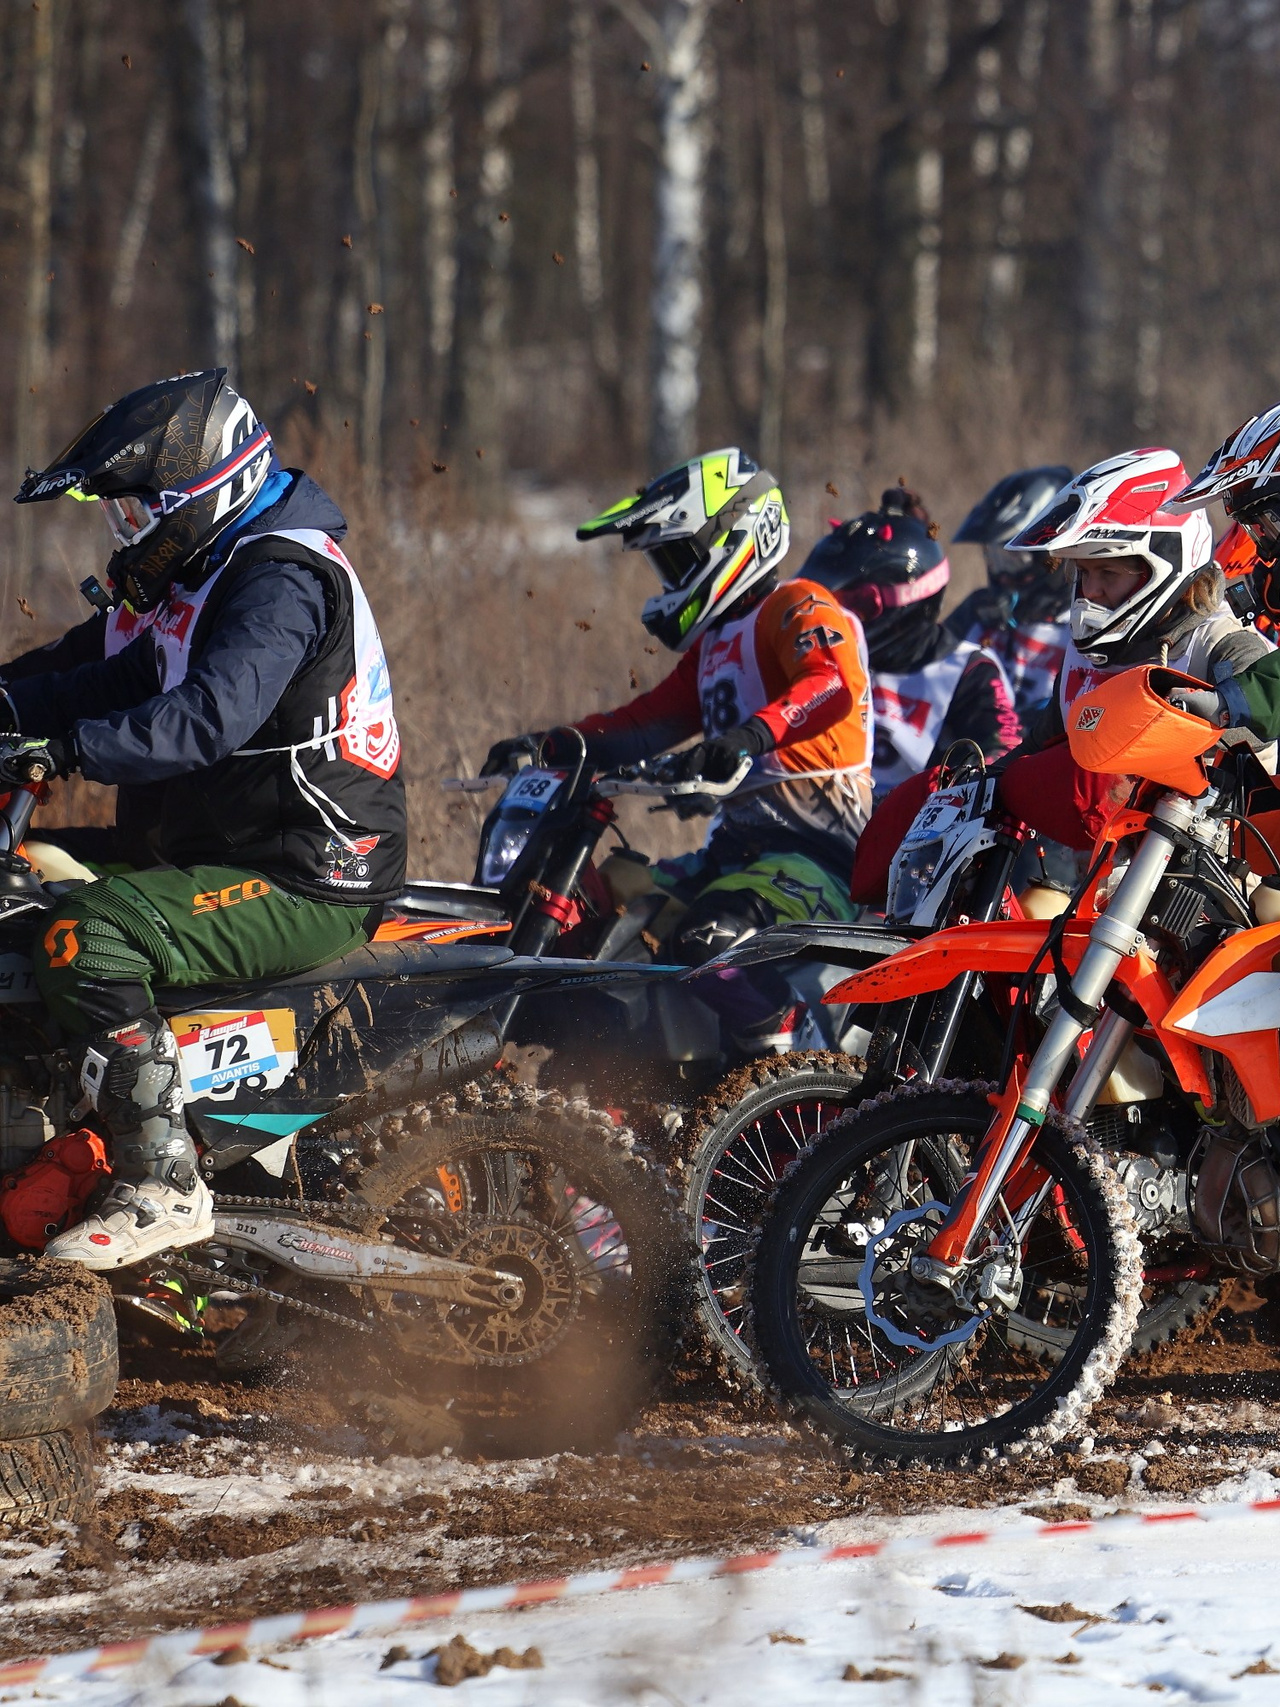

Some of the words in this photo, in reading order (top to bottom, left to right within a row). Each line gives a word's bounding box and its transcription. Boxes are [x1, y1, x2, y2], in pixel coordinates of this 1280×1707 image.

[30, 472, 78, 498] Airoh
[204, 1034, 251, 1071] 72
[211, 1062, 261, 1085] AVANTIS
[236, 1223, 258, 1235] DID
[299, 1240, 355, 1262] RENTHAL
